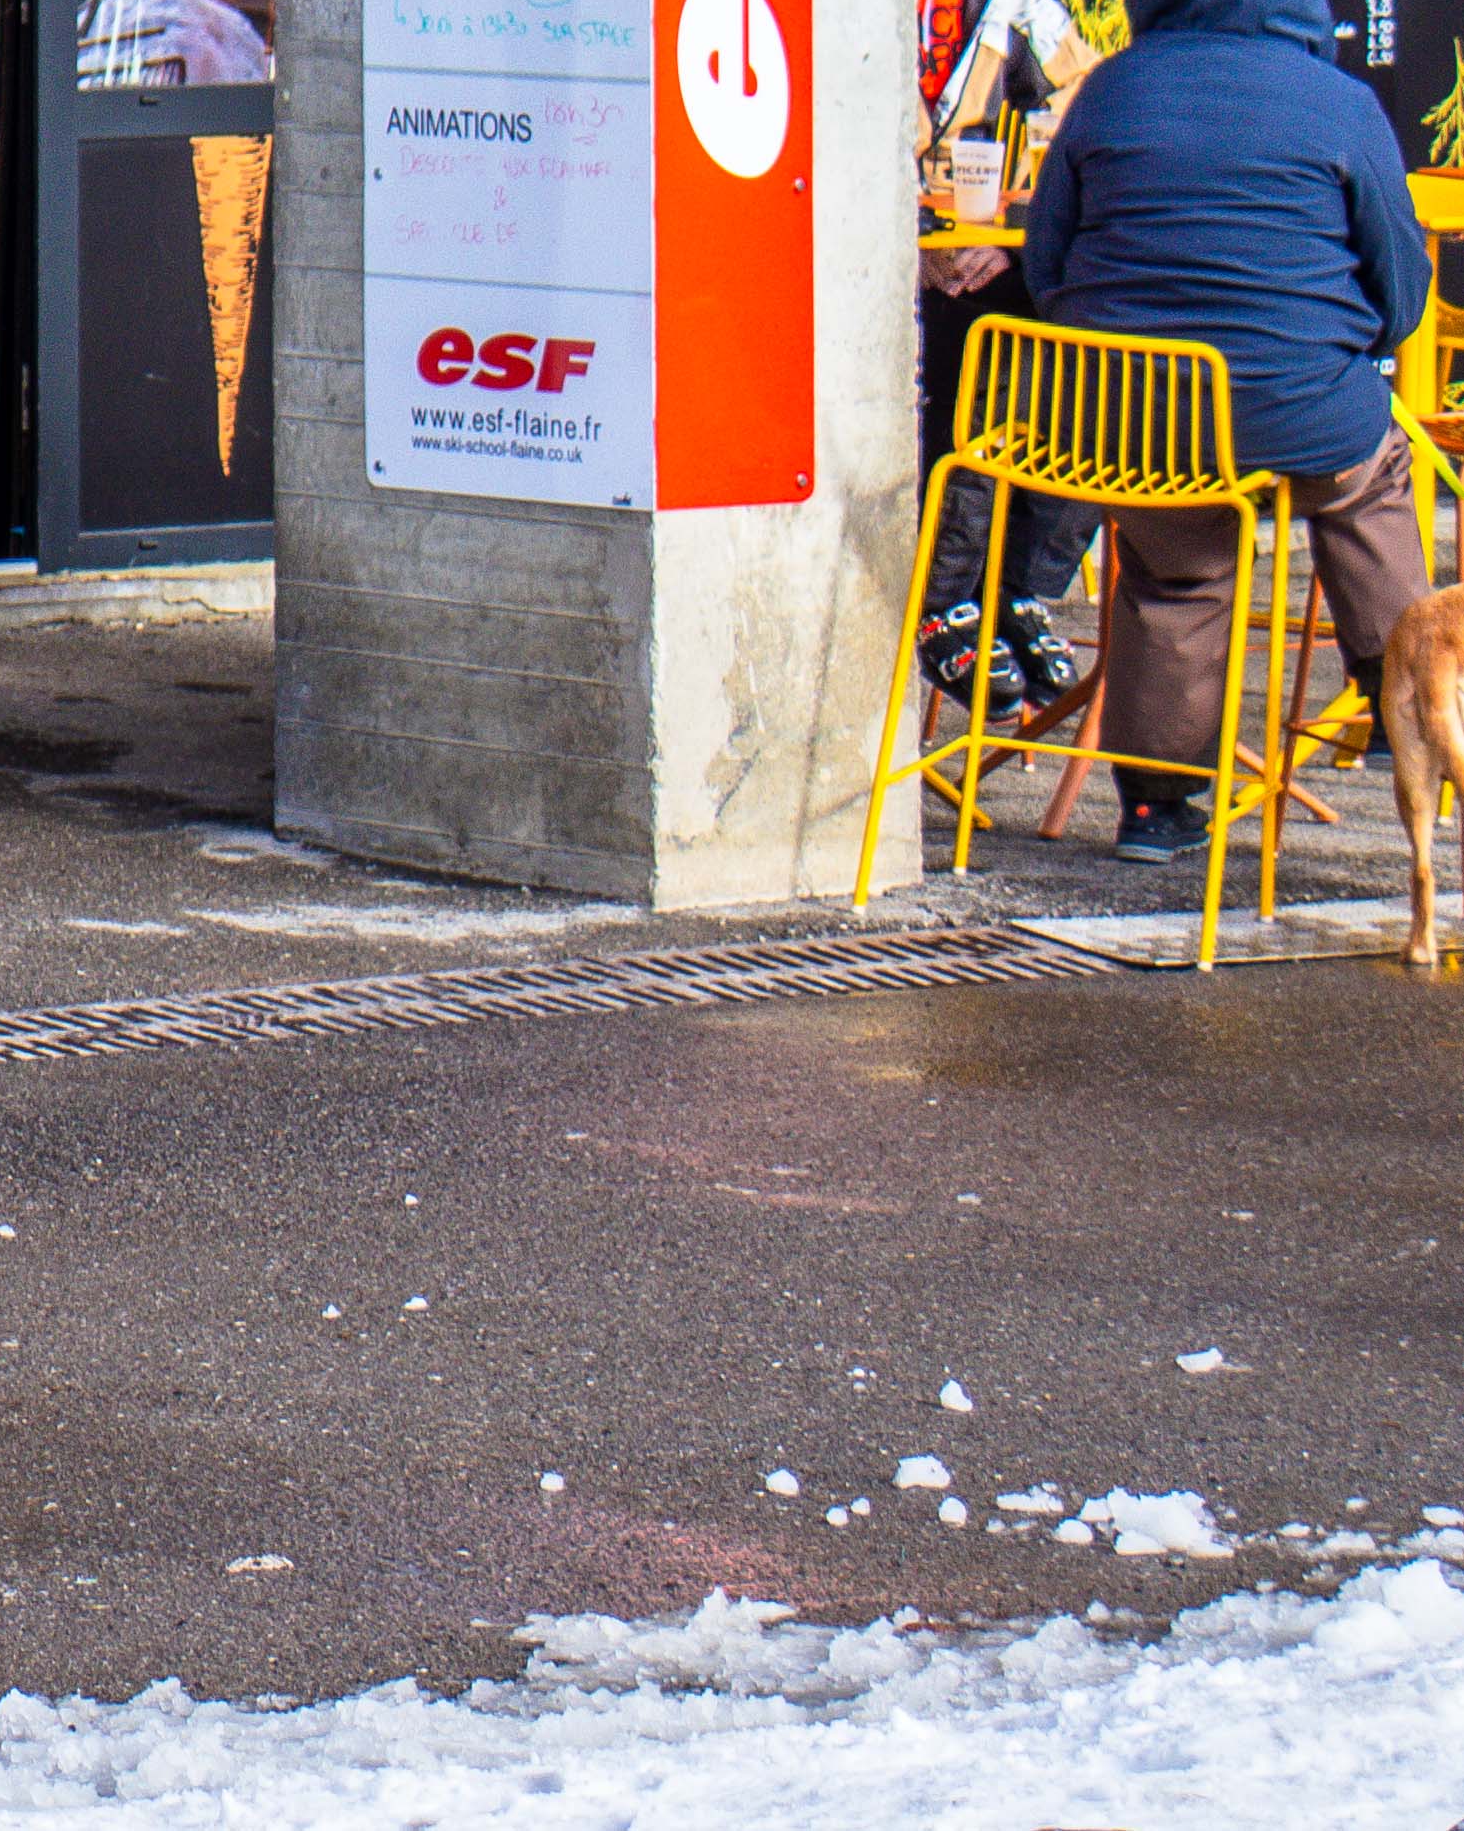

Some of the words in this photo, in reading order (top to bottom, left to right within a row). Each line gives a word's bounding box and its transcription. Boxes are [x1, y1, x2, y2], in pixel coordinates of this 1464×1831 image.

[386, 106, 533, 143] ANIMATIONS
[411, 406, 603, 442] www.esf-flaine.fr
[411, 433, 584, 464] www.ski-school-flaine.co.uk
